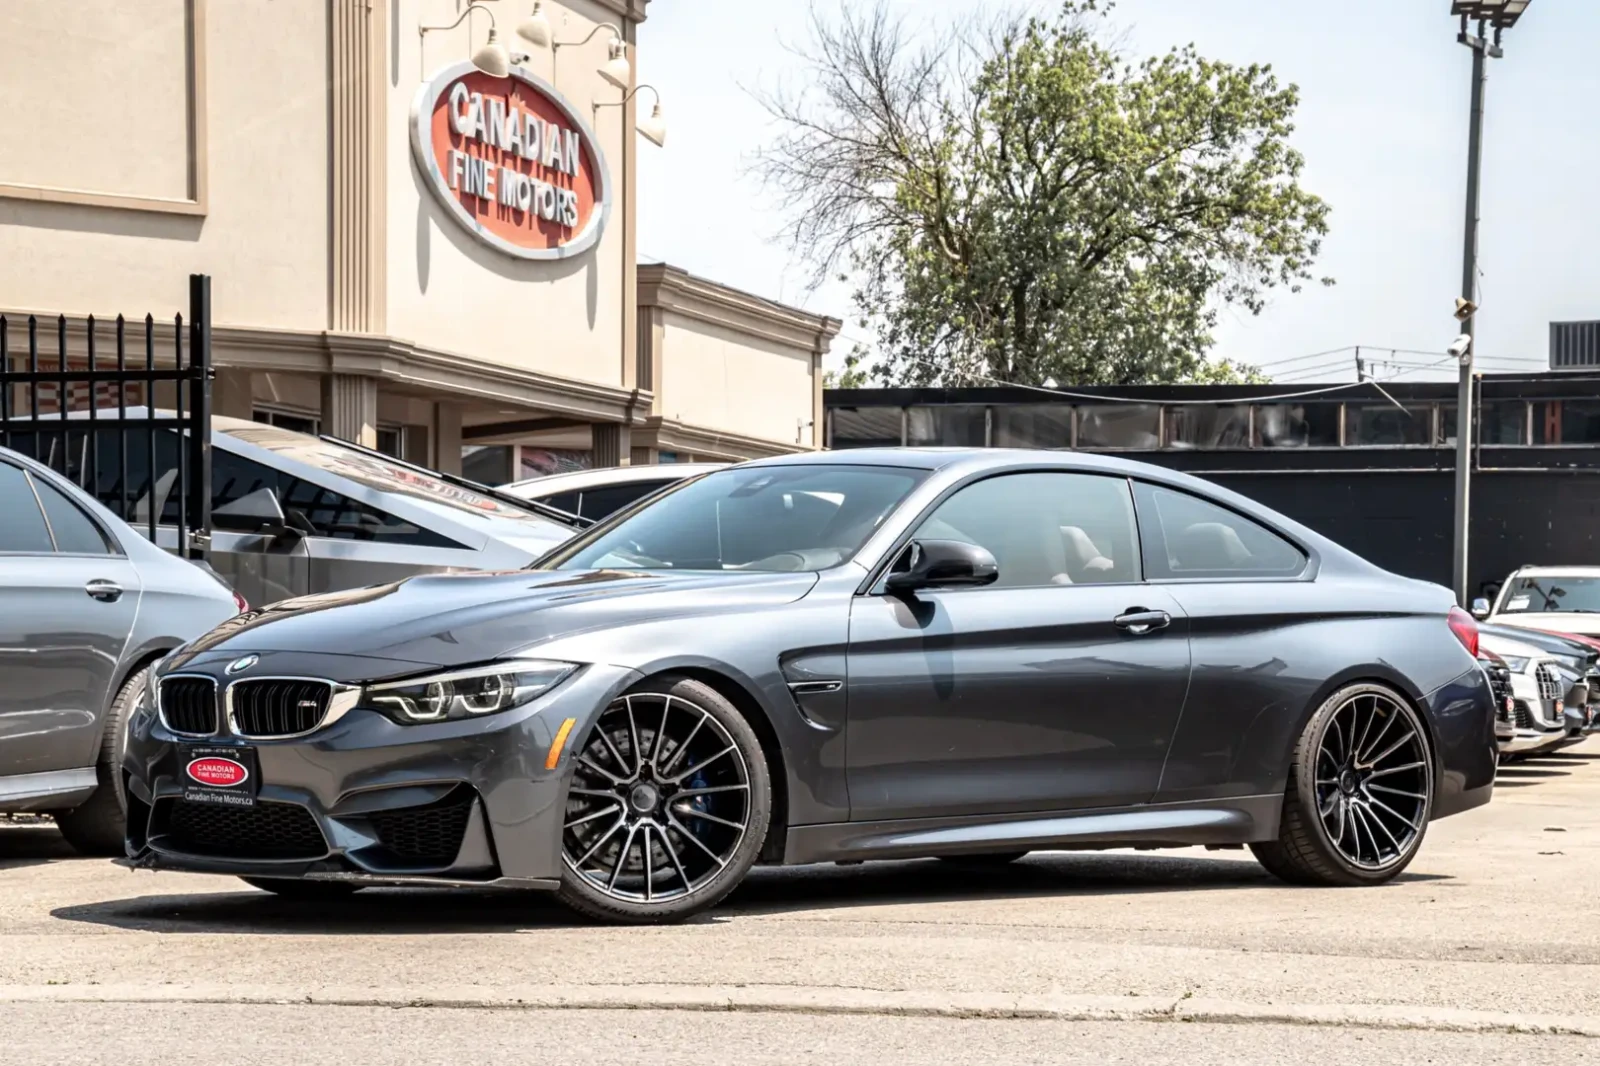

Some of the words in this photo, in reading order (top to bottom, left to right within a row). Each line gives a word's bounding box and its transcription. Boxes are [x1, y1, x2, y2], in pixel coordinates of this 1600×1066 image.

[449, 82, 579, 177] CANADIAN
[448, 149, 495, 200] FINE
[498, 167, 578, 227] MOTORS
[197, 764, 235, 773] CANADIAN
[185, 791, 210, 802] Canadian
[211, 793, 223, 803] Fine
[224, 795, 253, 806] Motors.ca
